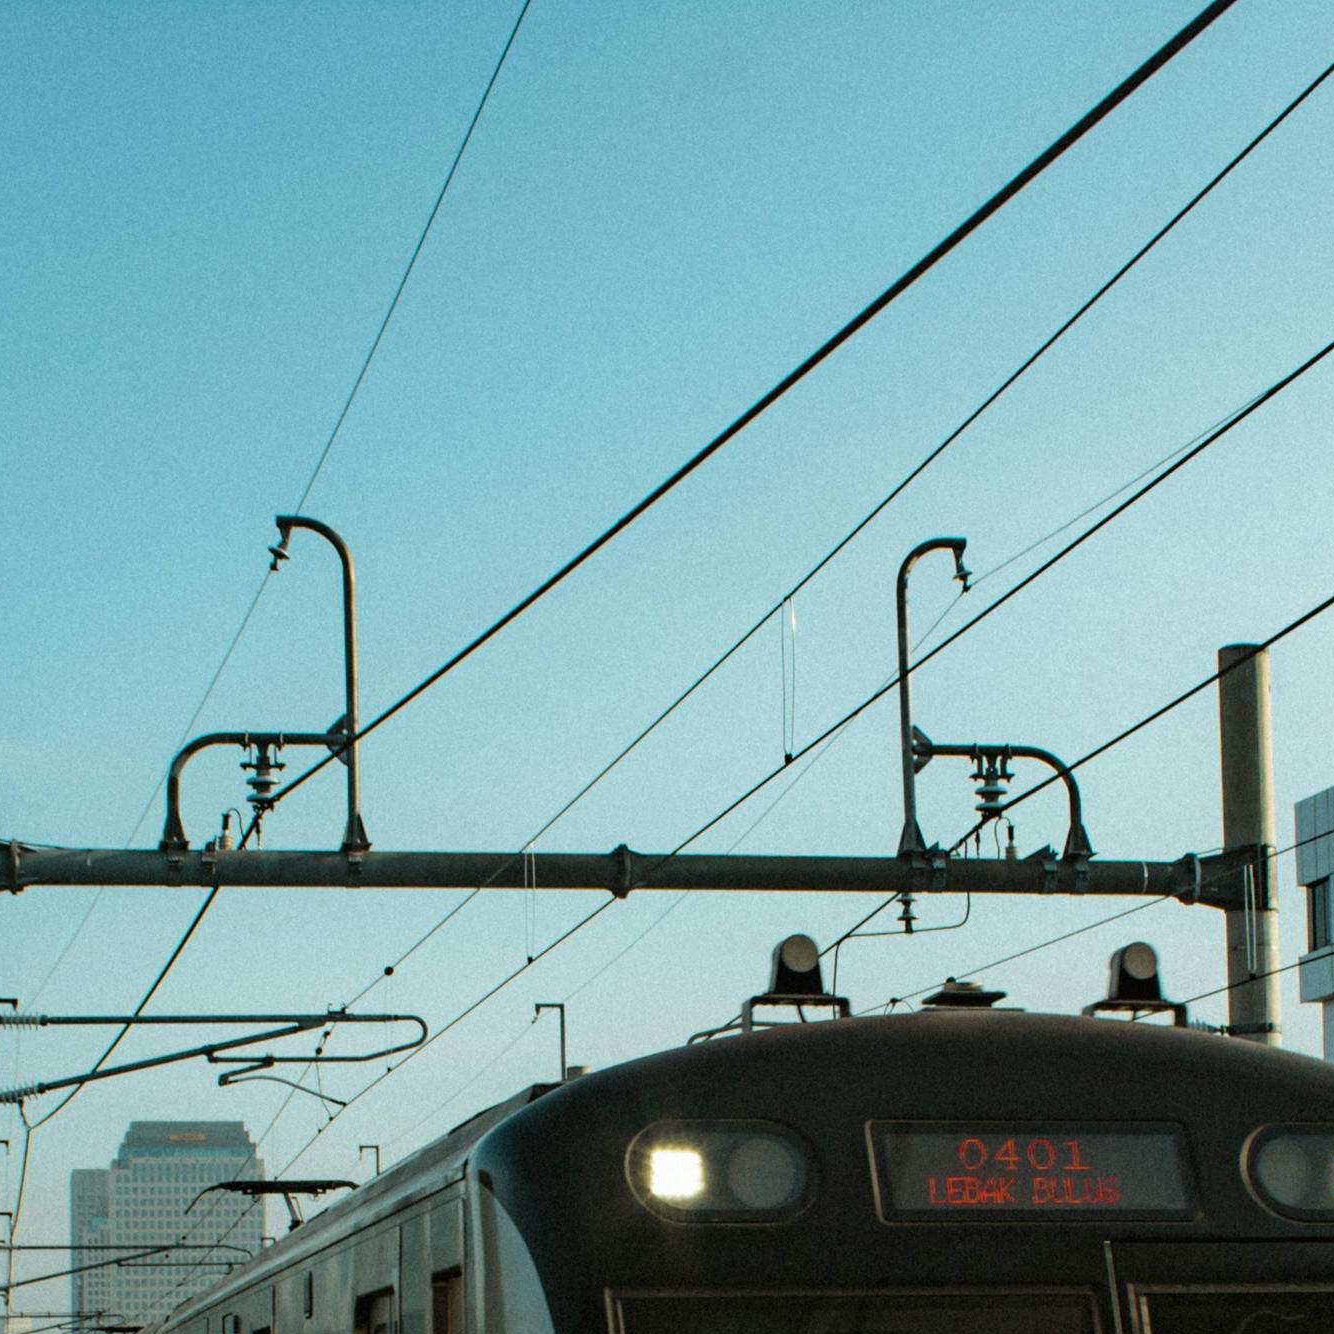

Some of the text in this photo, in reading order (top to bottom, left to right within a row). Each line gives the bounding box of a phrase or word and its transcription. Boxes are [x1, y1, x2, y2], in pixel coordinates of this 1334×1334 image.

[958, 1138, 1091, 1171] 0401
[928, 1175, 1120, 1205] LEBAK BULUS
